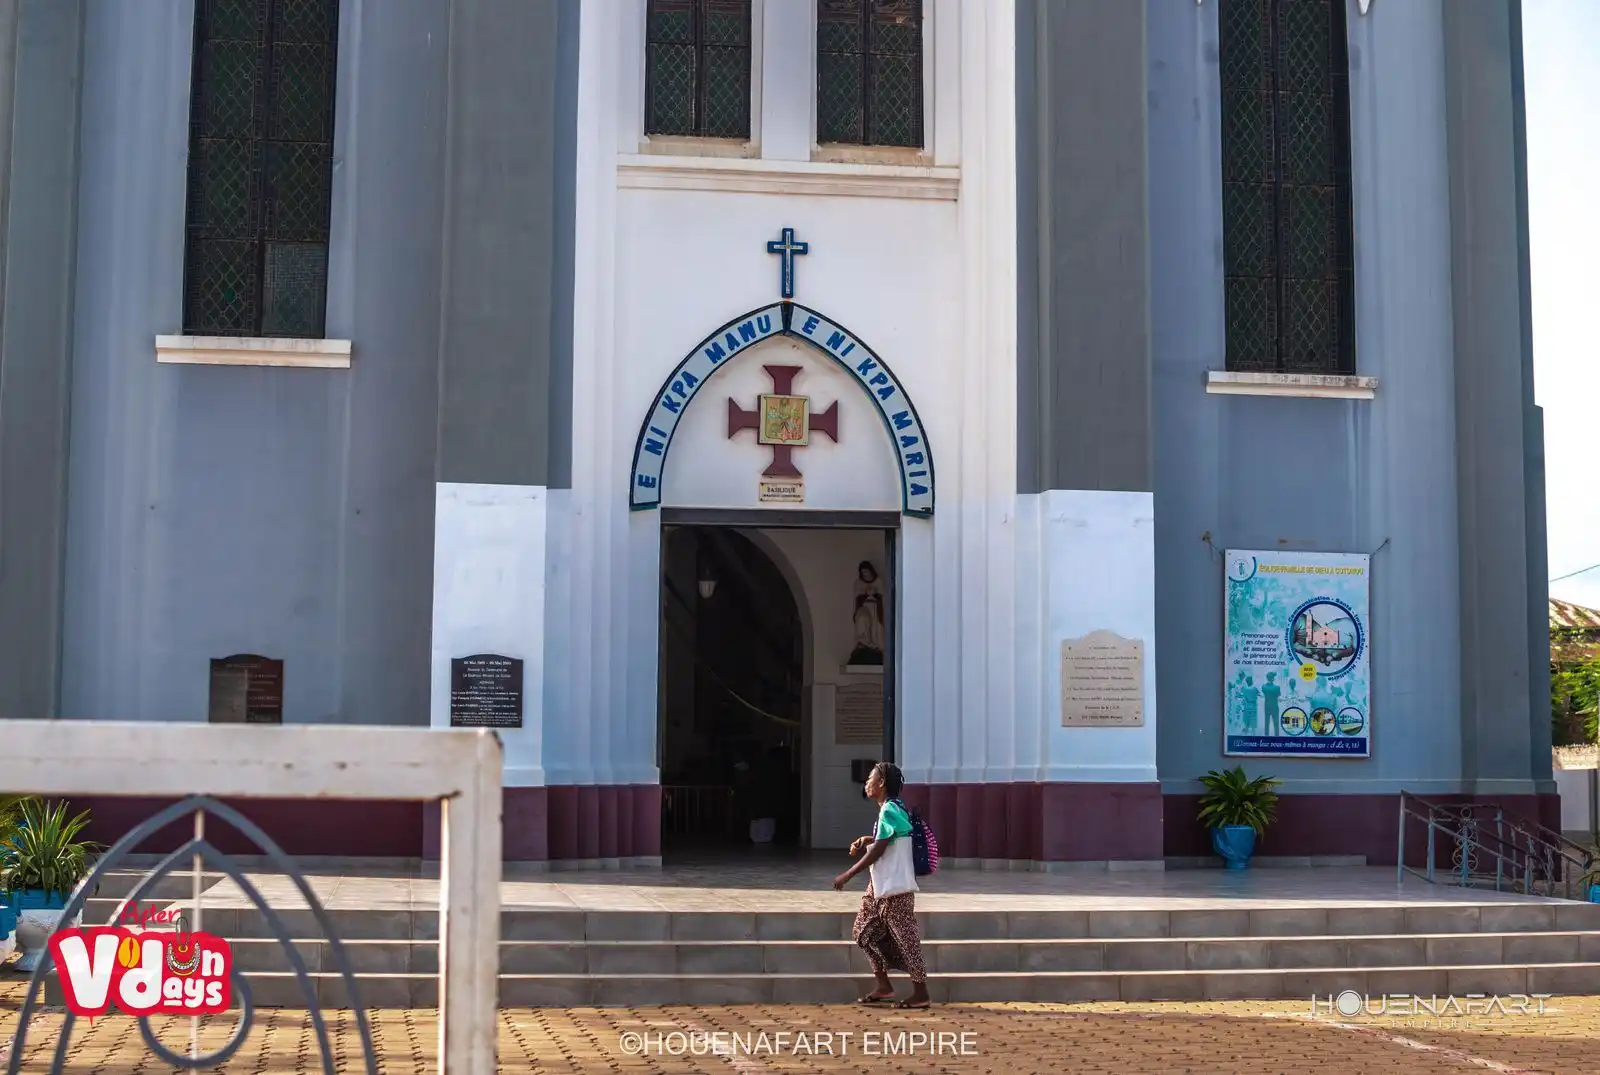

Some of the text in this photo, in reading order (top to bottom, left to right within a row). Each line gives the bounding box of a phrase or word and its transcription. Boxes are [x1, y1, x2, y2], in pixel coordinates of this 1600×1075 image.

[637, 314, 772, 489] E NI KPA MAWU
[802, 315, 929, 496] E NI KPA MARIA
